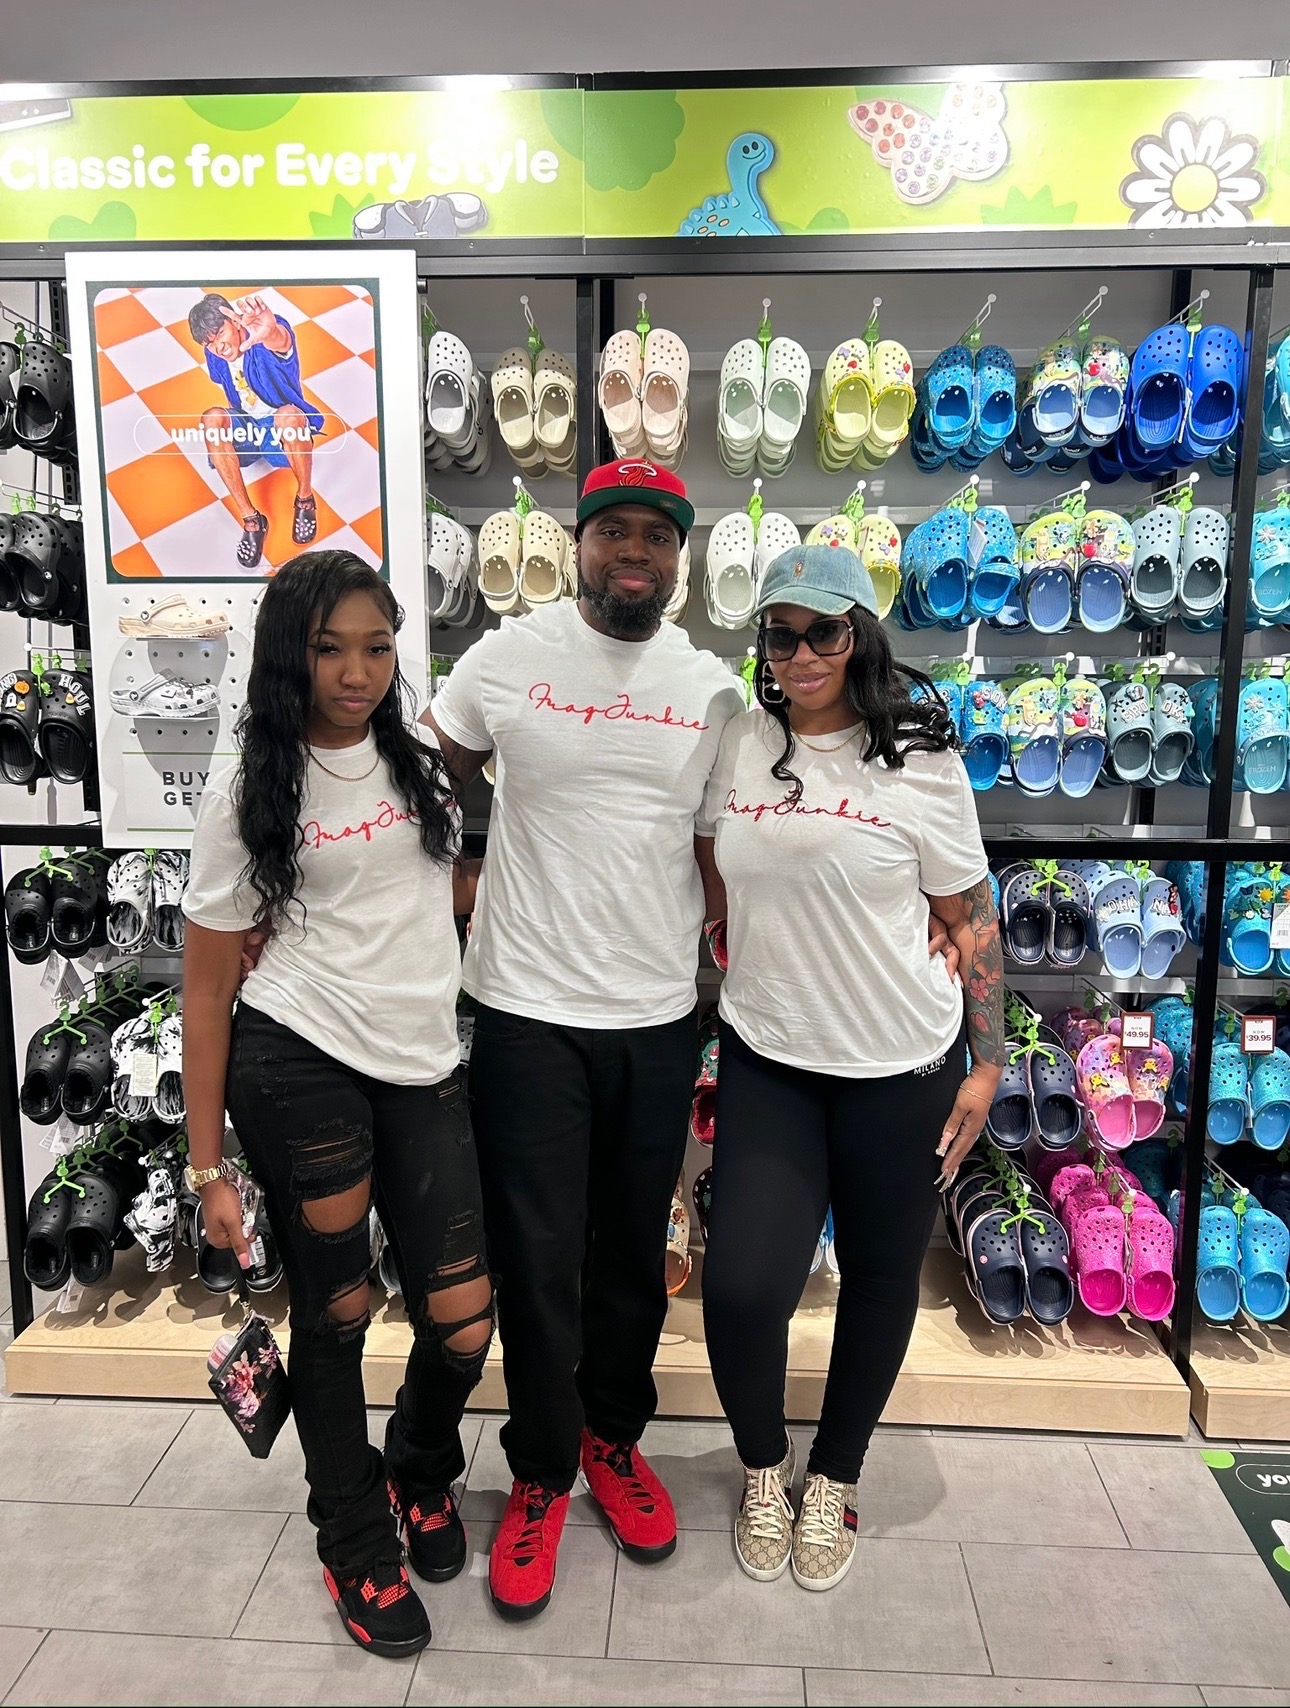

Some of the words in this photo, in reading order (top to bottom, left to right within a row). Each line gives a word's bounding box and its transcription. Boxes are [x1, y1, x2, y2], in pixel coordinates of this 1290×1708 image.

[0, 145, 176, 190] Classic
[184, 143, 264, 188] for
[275, 142, 417, 194] Every
[426, 140, 559, 194] Style
[171, 422, 267, 446] uniquely
[162, 771, 210, 786] BUY
[913, 1056, 946, 1074] MILANO
